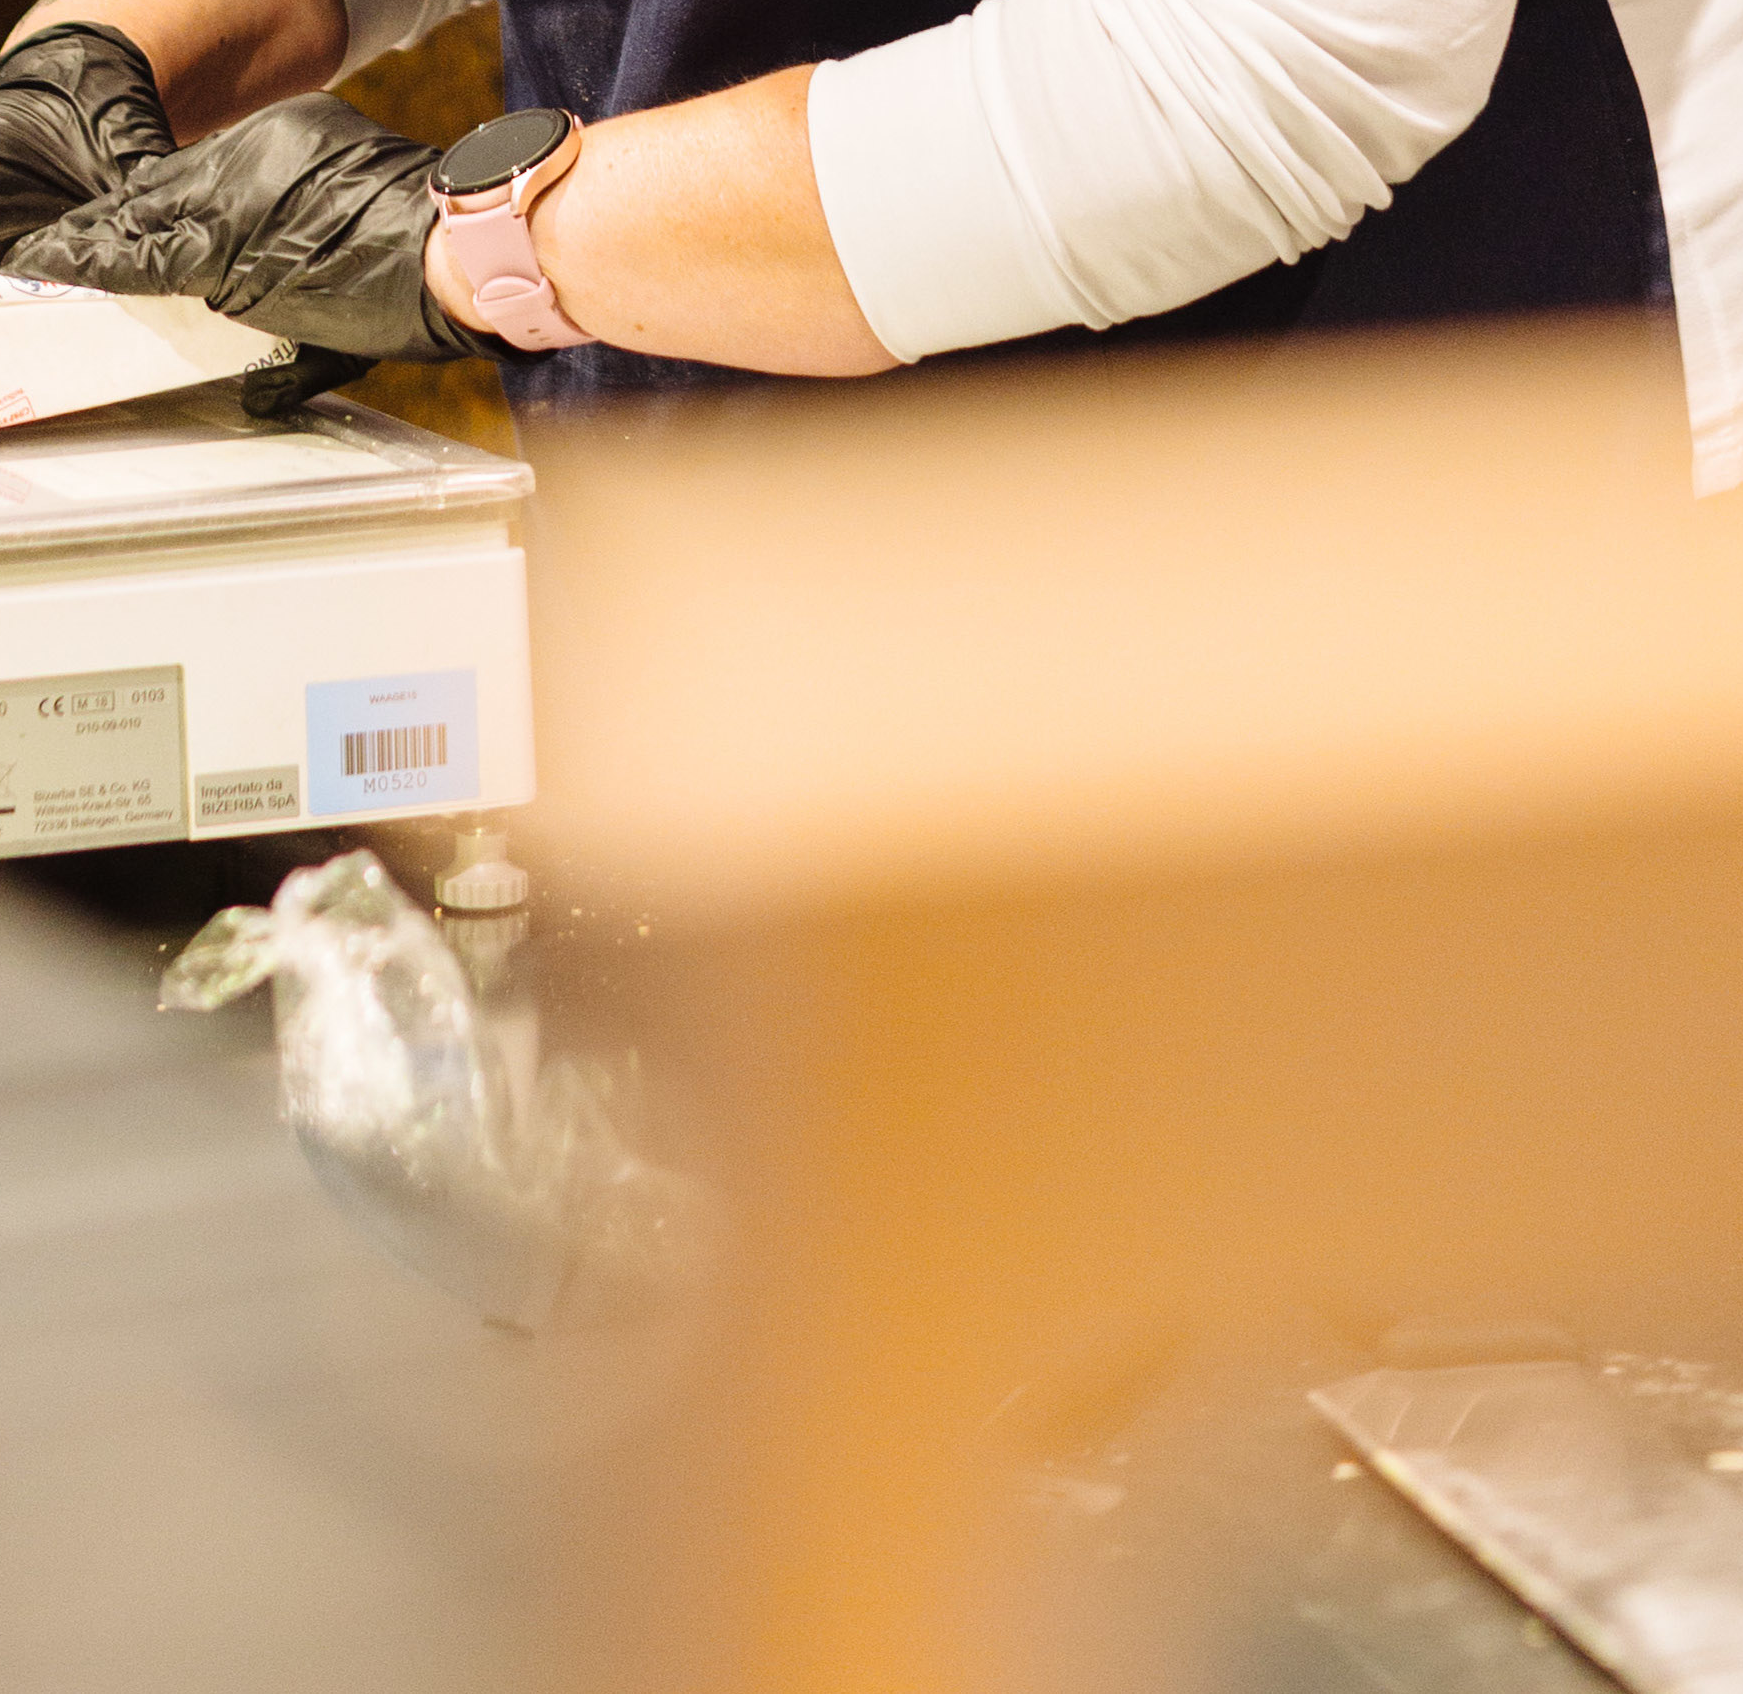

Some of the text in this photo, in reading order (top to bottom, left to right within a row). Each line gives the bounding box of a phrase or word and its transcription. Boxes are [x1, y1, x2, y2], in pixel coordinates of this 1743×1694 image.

[131, 688, 166, 704] 0103
[201, 776, 283, 799] Importato da
[201, 793, 296, 816] BIZERBA SpA
